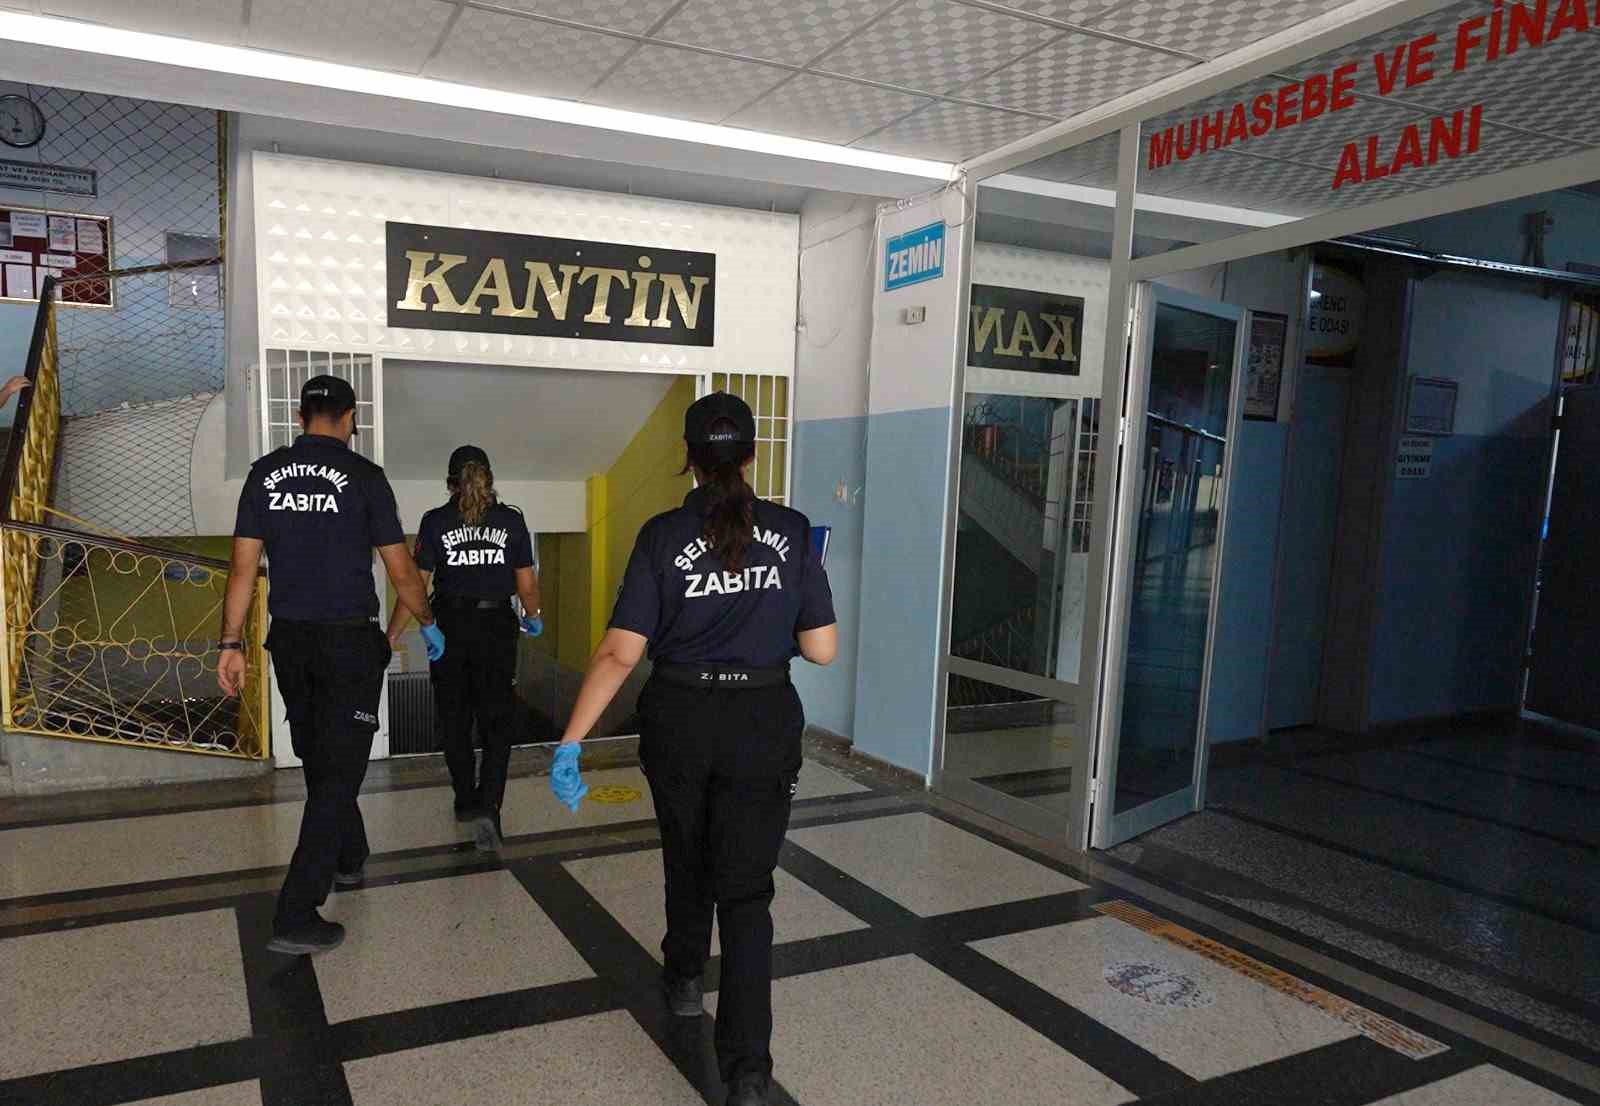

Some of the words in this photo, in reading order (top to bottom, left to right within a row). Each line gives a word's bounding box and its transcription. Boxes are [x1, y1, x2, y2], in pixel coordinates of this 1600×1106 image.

[1147, 63, 1359, 171] MUHASEBE
[1373, 33, 1437, 97] VE
[1451, 0, 1600, 72] FİNA
[1331, 104, 1483, 191] ALANI
[888, 236, 942, 281] ZEMİN
[396, 249, 710, 330] KANTİN
[710, 433, 733, 441] ZABITA
[263, 462, 349, 493] ŞEHİTKAMİL
[268, 492, 339, 513] ZABITA
[441, 524, 508, 551] ŞEHİTKAMİL
[674, 525, 790, 572] ŞEHAMİL
[446, 548, 505, 566] ZABITA
[685, 565, 782, 598] ZABITA
[700, 672, 748, 681] ZBITA
